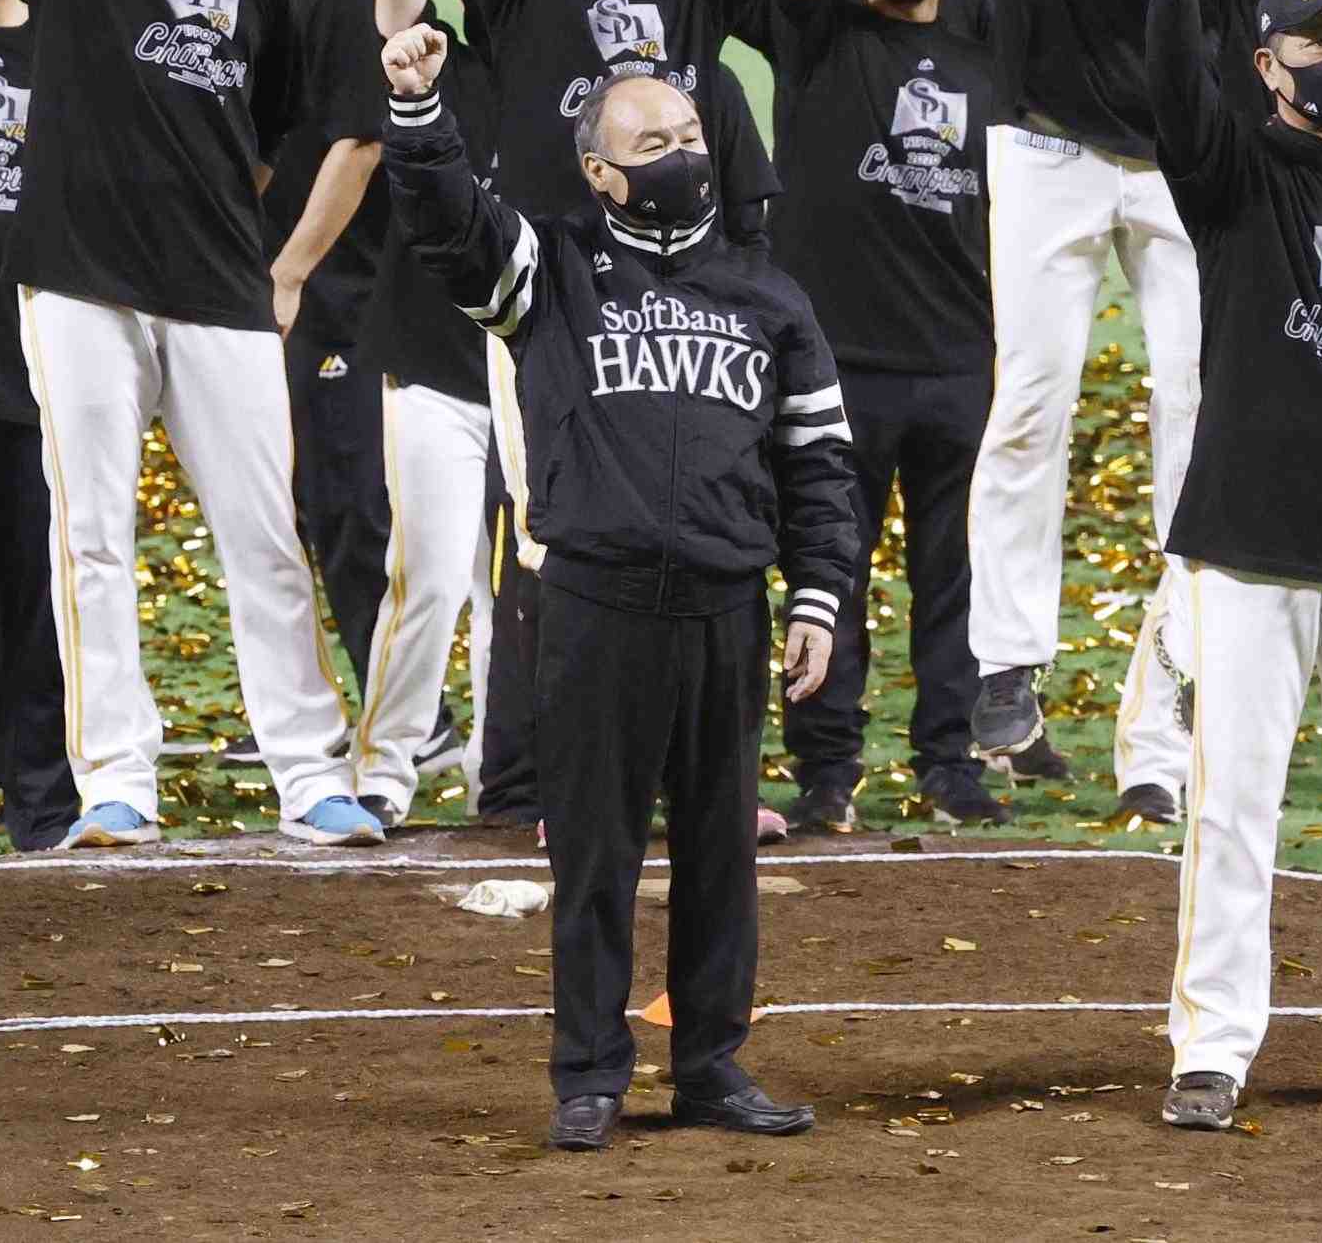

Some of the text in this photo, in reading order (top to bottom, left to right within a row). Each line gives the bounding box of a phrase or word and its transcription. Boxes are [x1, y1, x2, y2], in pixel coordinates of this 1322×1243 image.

[208, 11, 230, 31] V4
[4, 121, 26, 139] V4
[600, 291, 752, 341] SoftBank
[586, 333, 771, 411] HAWKS
